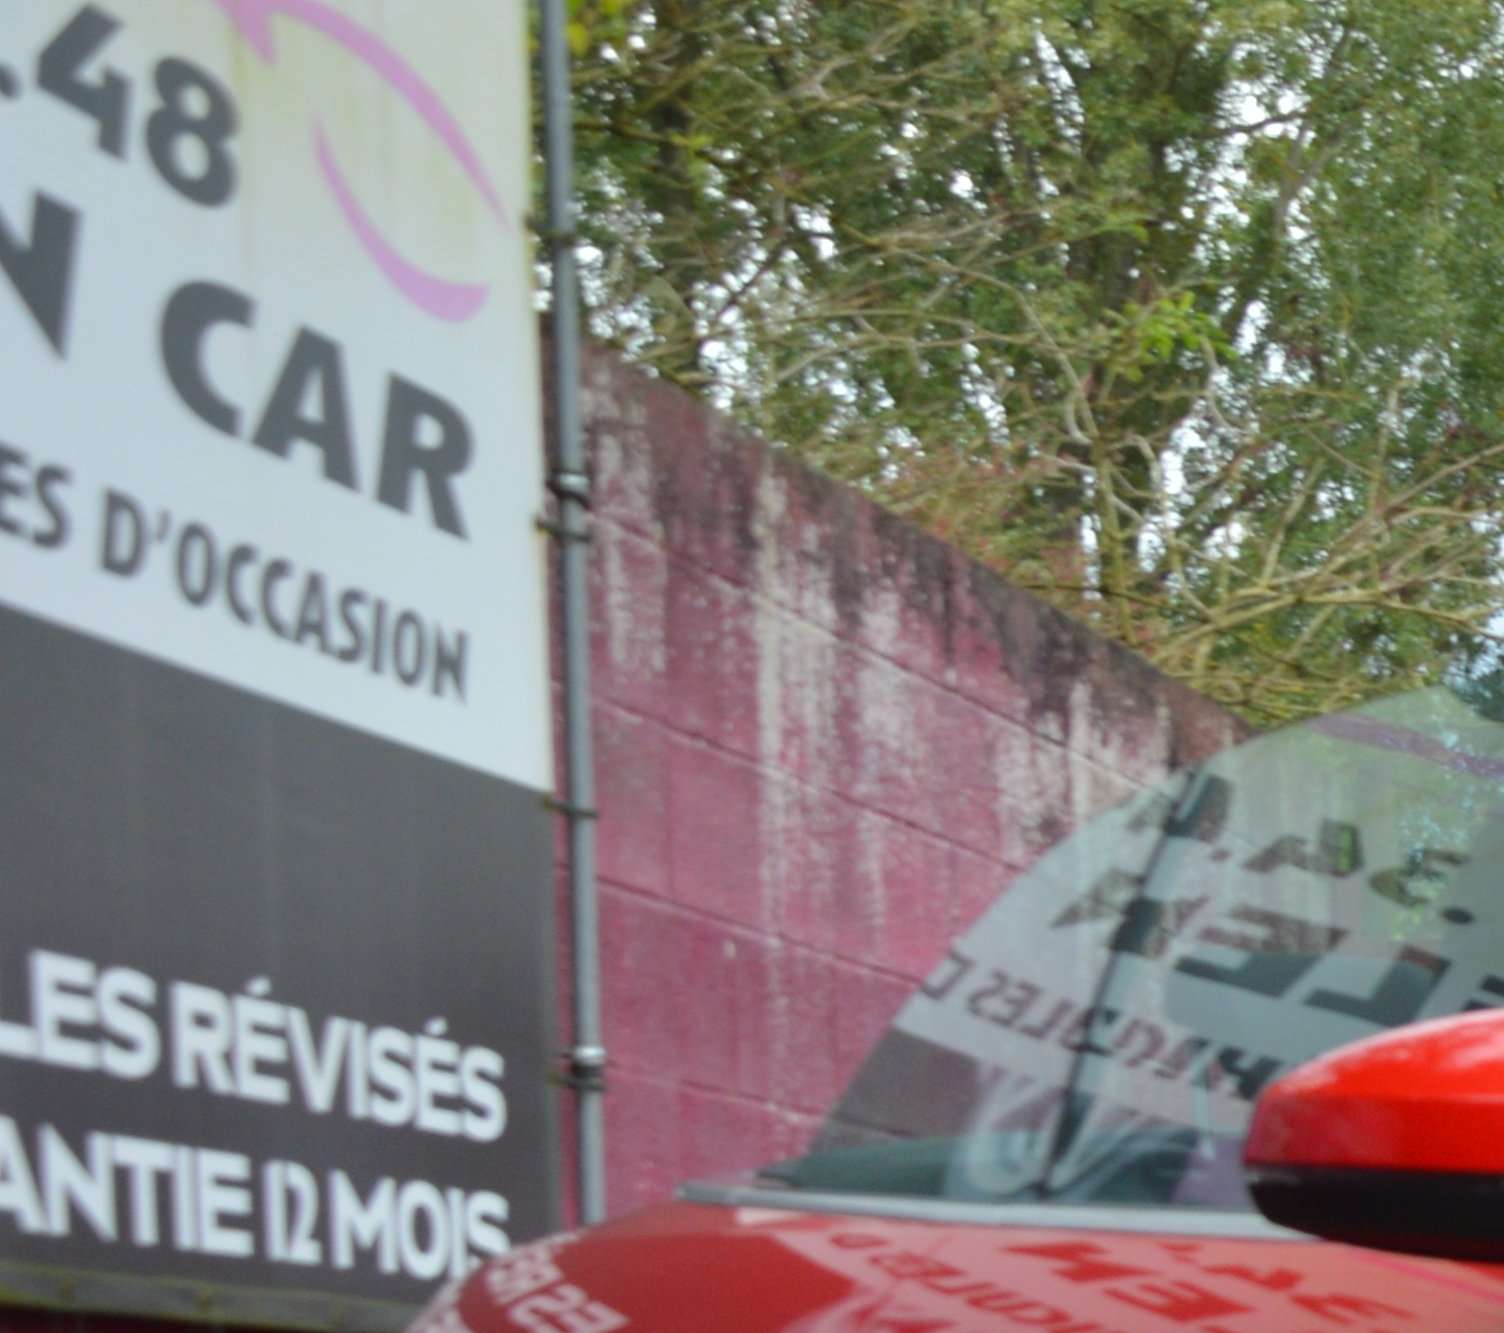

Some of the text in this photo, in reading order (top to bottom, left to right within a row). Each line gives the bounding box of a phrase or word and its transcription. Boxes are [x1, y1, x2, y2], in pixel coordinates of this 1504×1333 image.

[160, 278, 475, 542] CAR
[99, 487, 470, 702] D'OCCASION
[169, 977, 507, 1142] RÉVISÉS
[328, 1168, 510, 1281] MOIS
